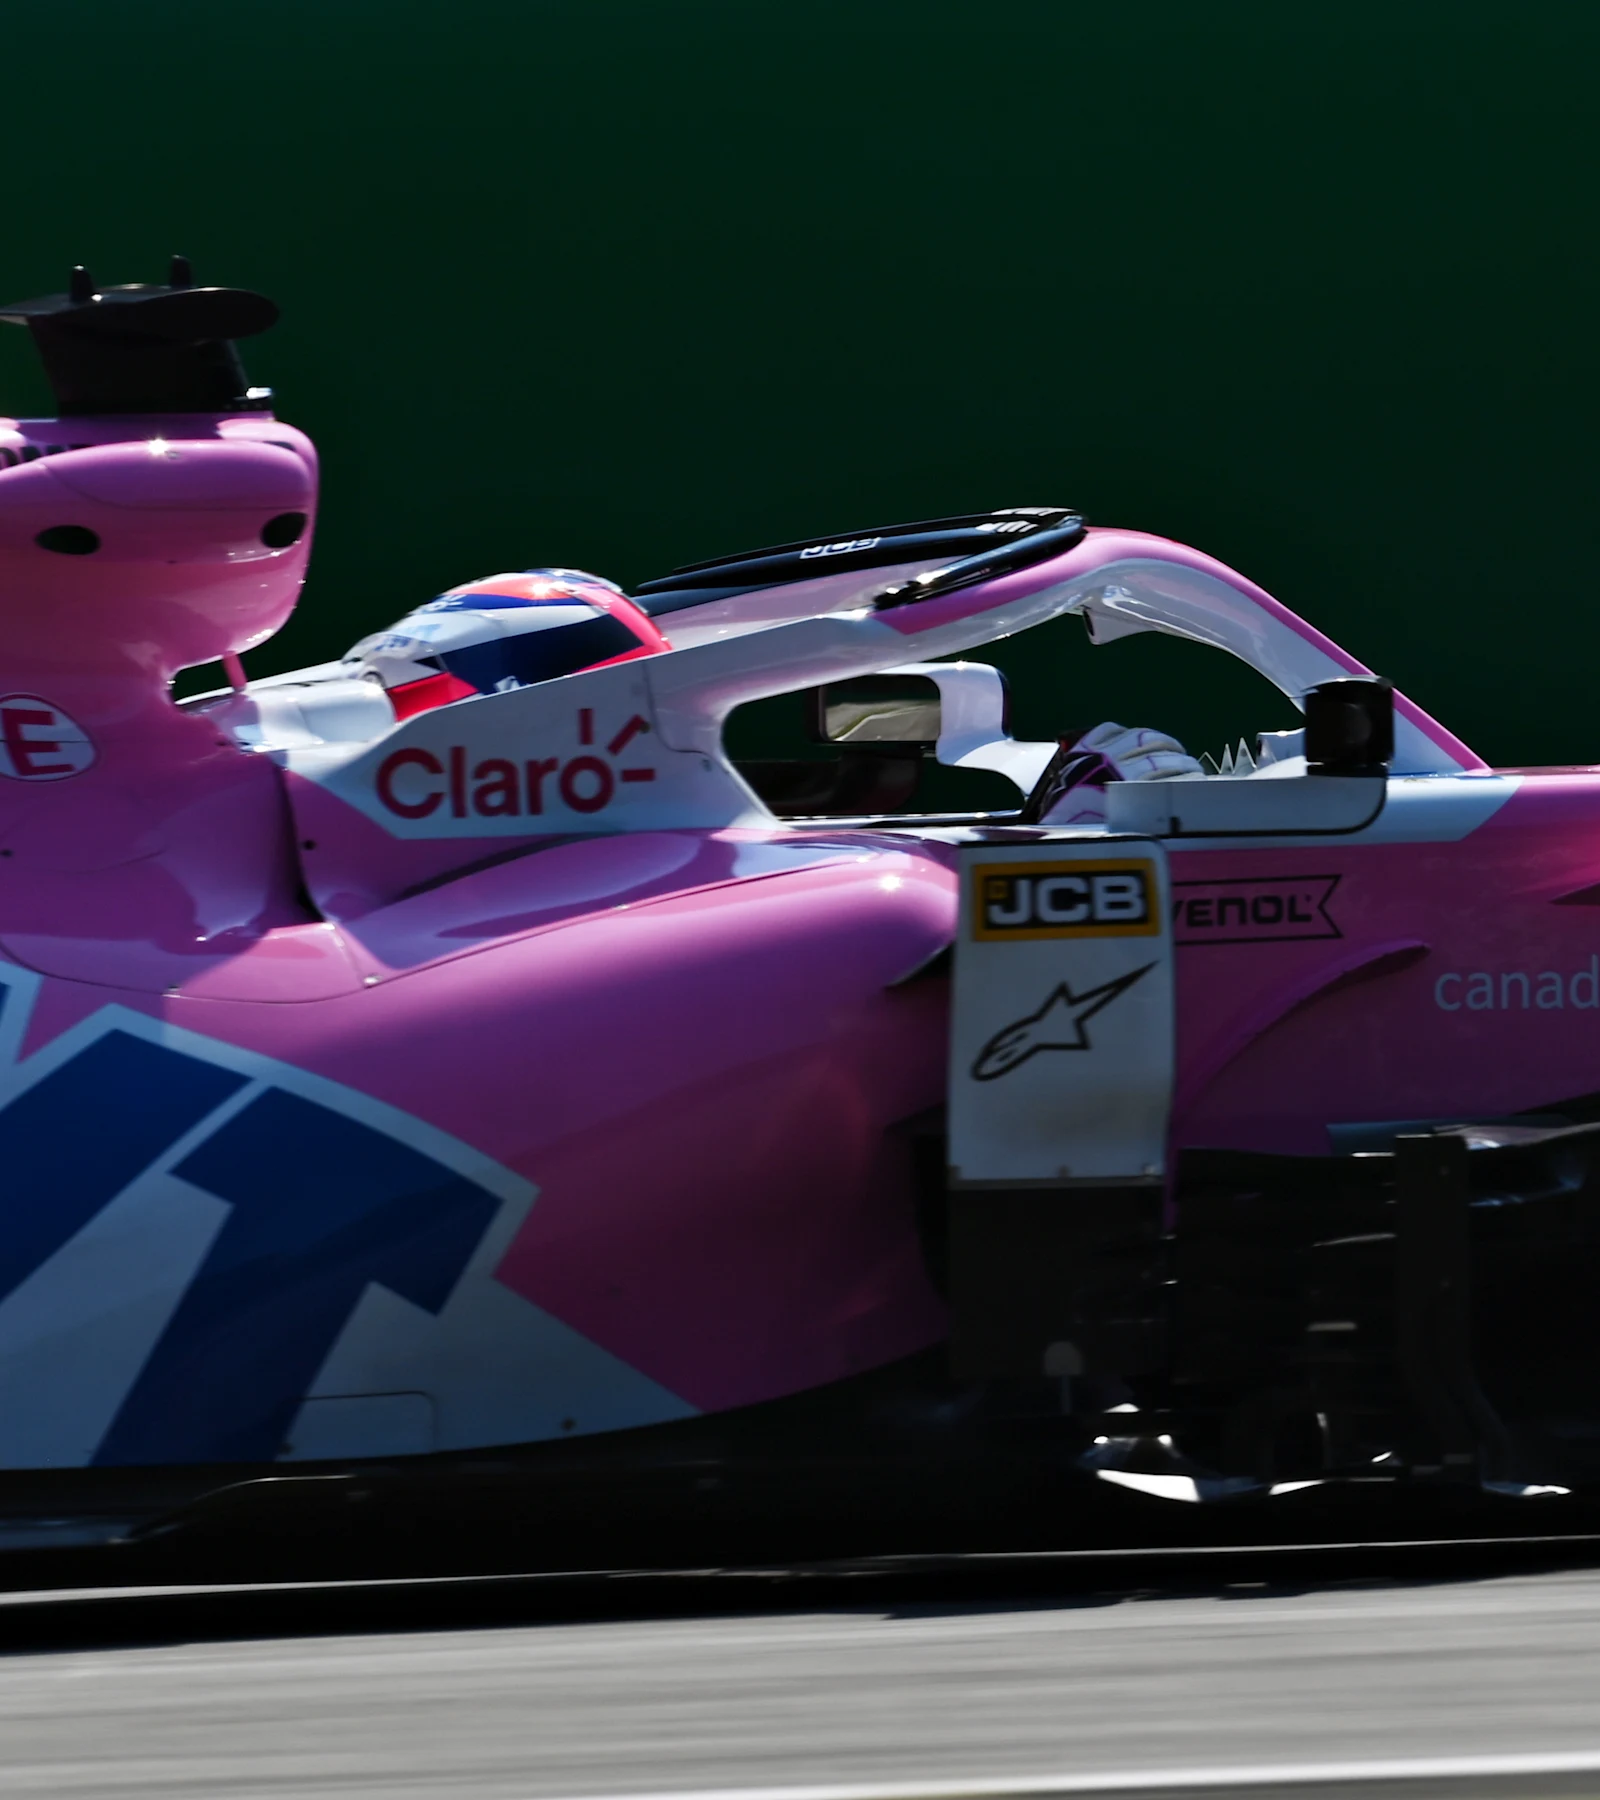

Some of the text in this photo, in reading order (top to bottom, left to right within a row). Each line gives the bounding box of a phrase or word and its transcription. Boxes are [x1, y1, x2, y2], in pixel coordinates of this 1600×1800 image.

[1, 708, 75, 777] E
[375, 746, 615, 819] Claro
[986, 875, 1146, 925] JCB
